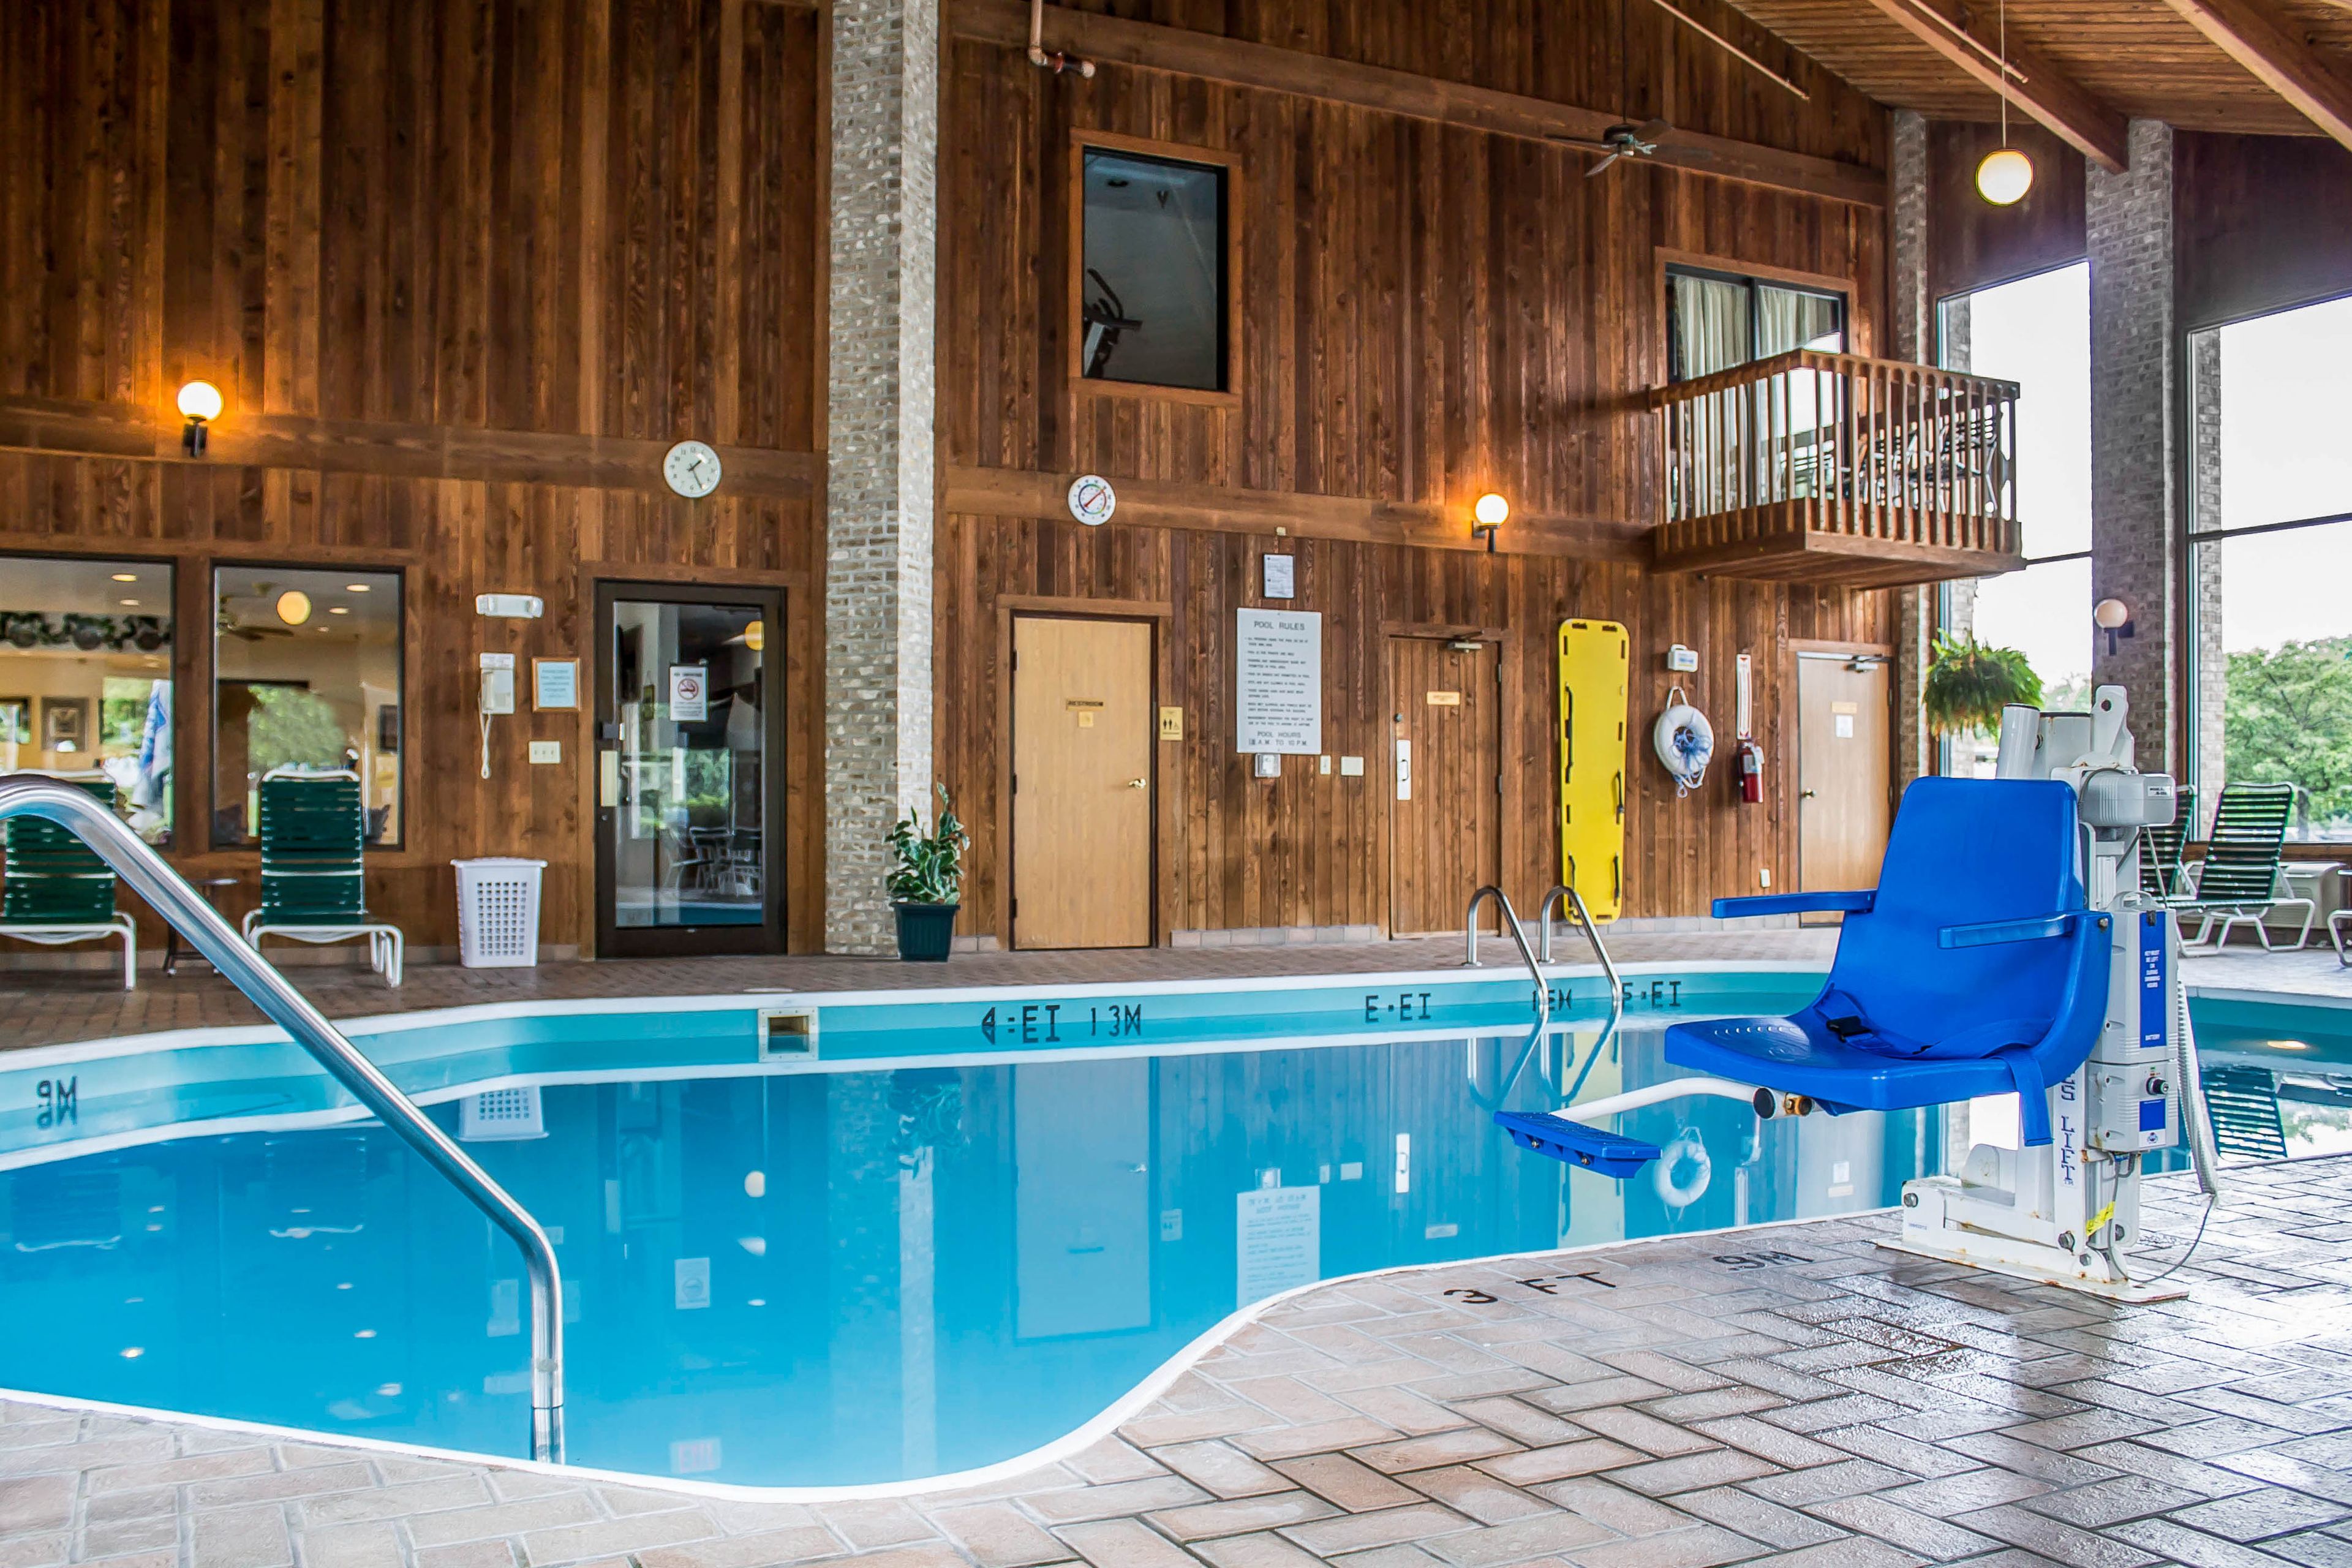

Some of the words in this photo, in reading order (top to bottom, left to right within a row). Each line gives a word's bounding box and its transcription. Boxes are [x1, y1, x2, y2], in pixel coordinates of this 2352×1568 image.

[1254, 620, 1274, 629] POOL
[2060, 1115, 2076, 1181] LIFT
[1443, 1289, 1498, 1304] 3
[1515, 1271, 1617, 1295] FT
